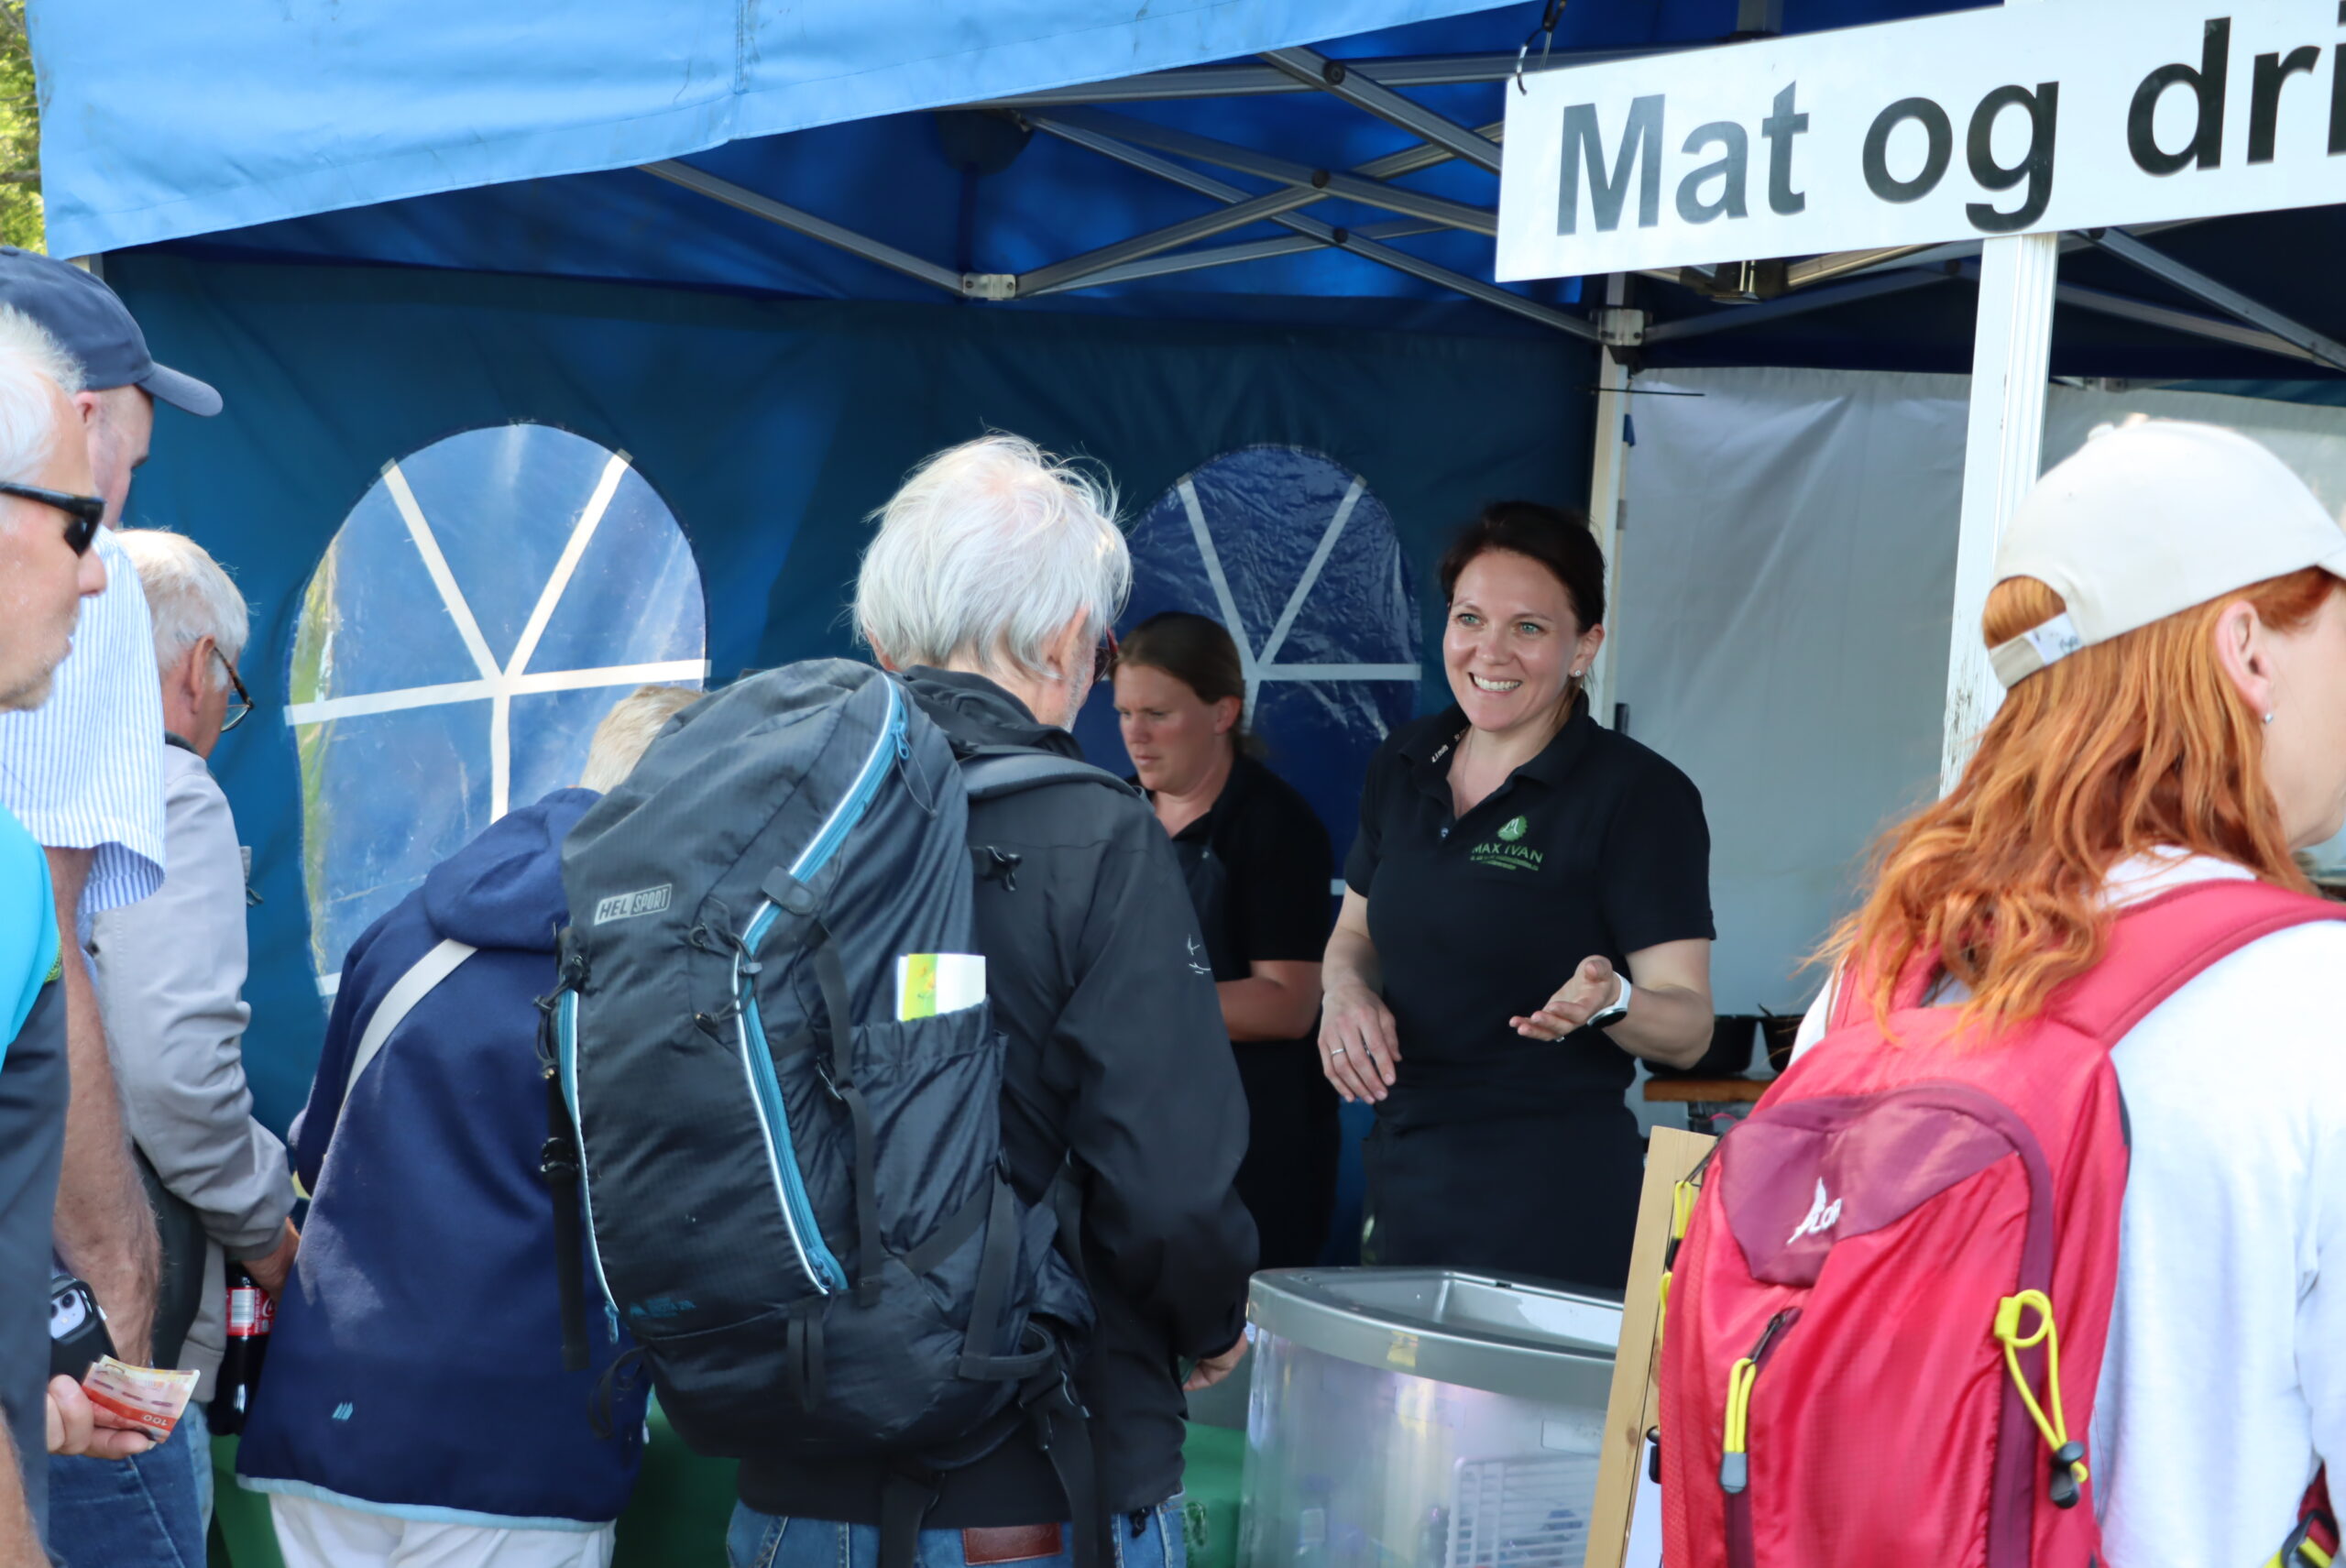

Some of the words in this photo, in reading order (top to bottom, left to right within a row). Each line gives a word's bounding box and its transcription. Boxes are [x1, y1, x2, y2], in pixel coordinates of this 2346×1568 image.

[1557, 81, 1809, 236] Mat
[1861, 81, 2059, 234] og
[1471, 842, 1502, 854] MAX
[1504, 844, 1543, 863] IVAN
[142, 1414, 168, 1425] 100
